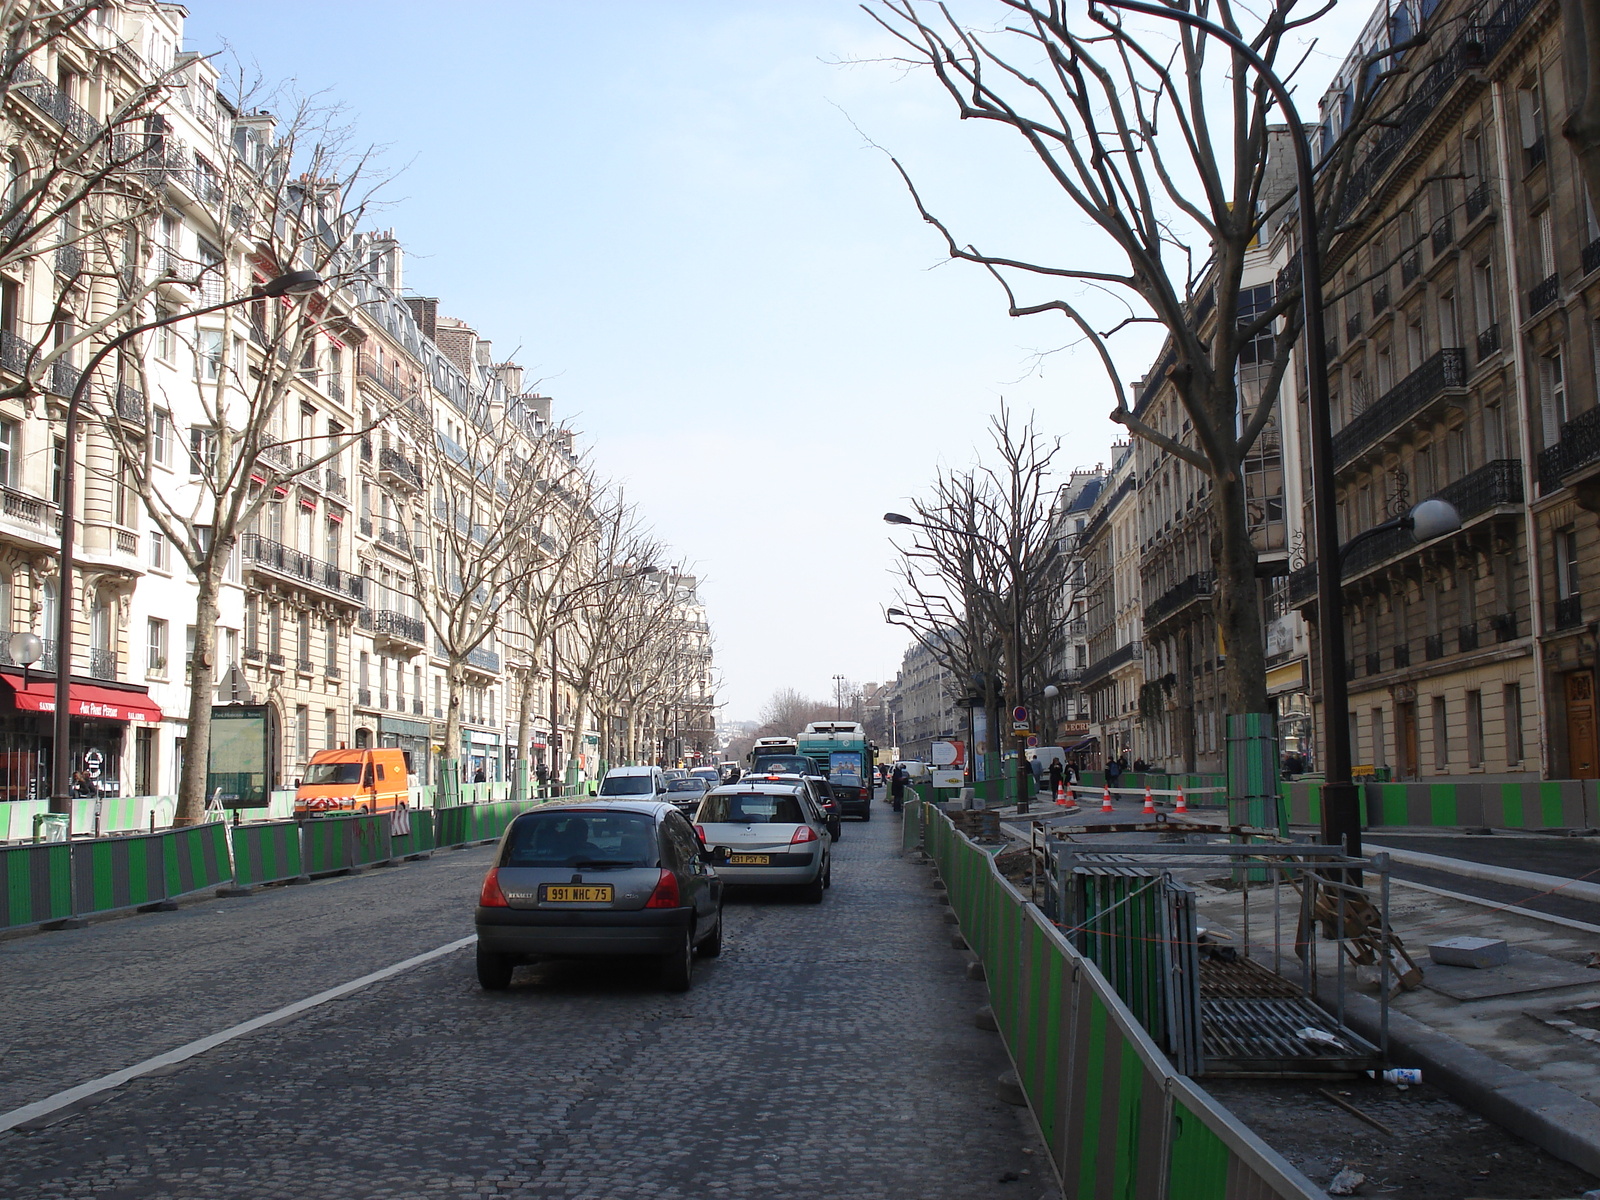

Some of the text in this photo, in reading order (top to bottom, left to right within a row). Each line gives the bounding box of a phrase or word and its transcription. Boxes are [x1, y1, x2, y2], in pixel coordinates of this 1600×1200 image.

[552, 888, 607, 900] 991 NHC 75
